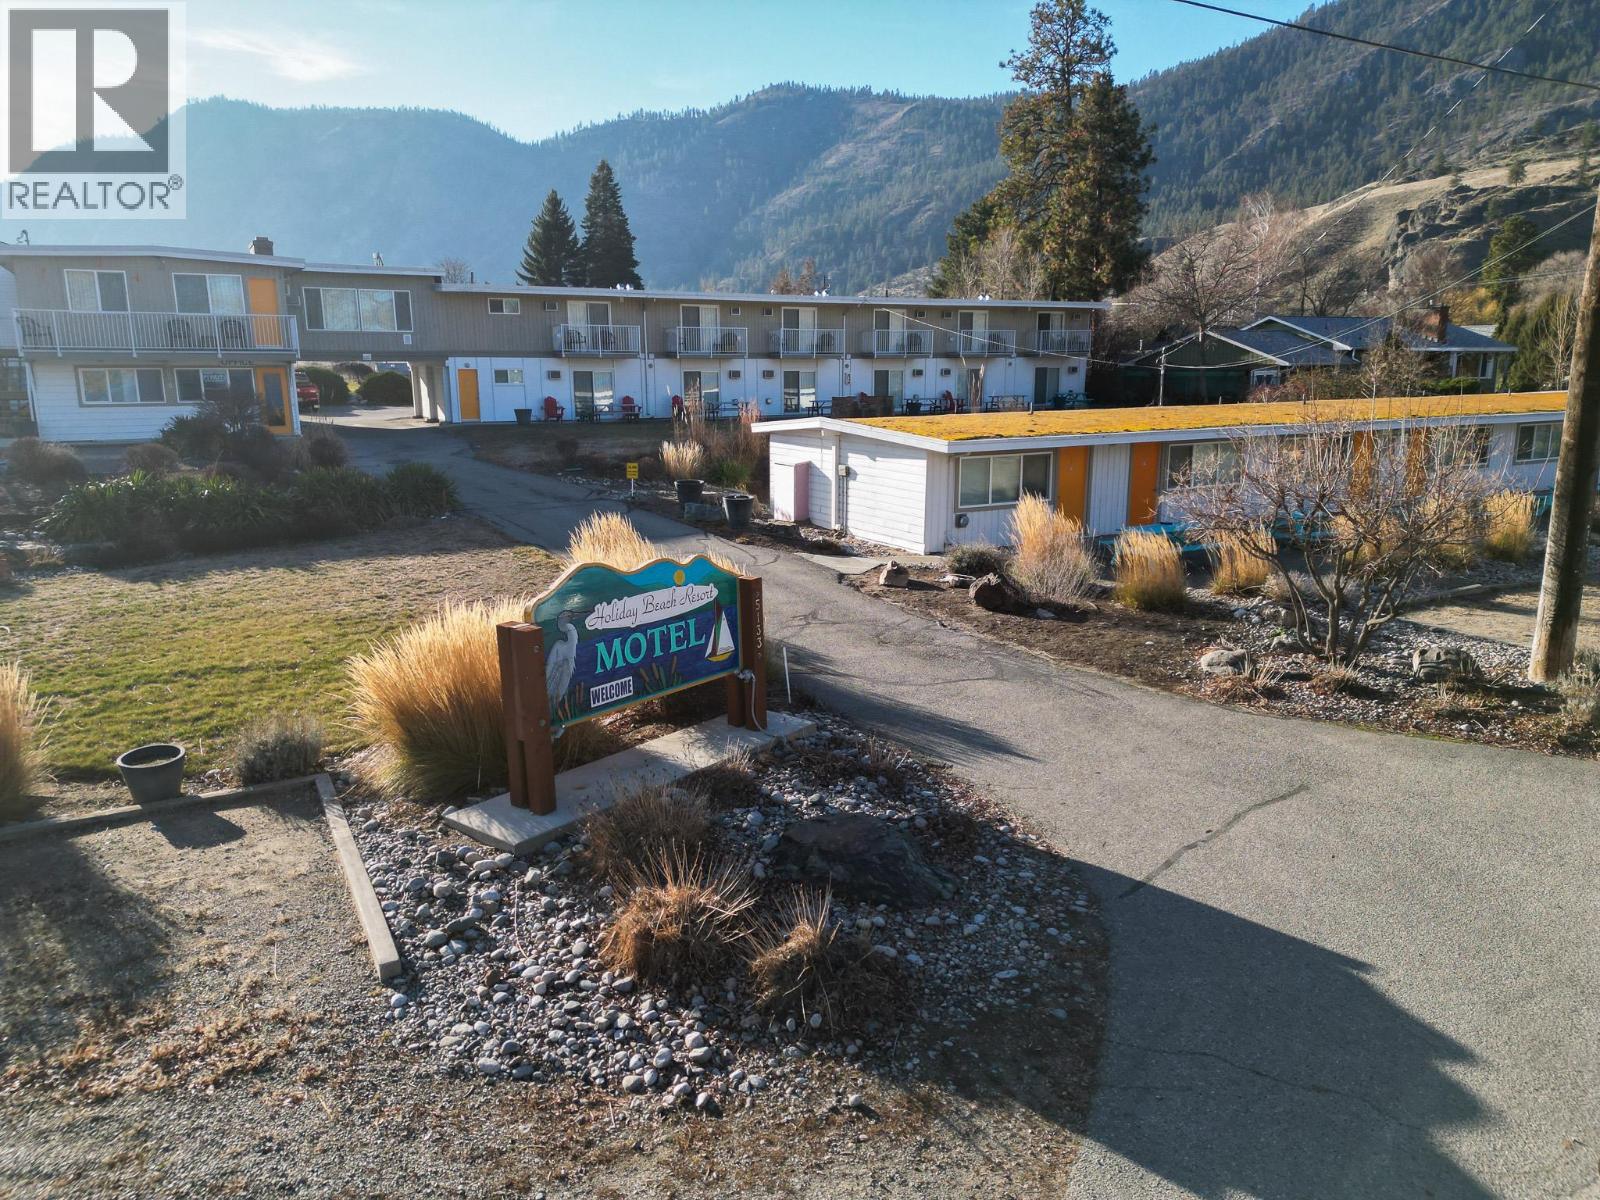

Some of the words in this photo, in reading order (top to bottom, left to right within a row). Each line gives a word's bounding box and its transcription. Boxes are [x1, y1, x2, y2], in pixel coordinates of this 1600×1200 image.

[588, 601, 637, 625] Holiday
[642, 588, 677, 615] Beach
[680, 585, 714, 606] Resort
[594, 618, 706, 674] MOTEL
[591, 679, 632, 704] WELCOME
